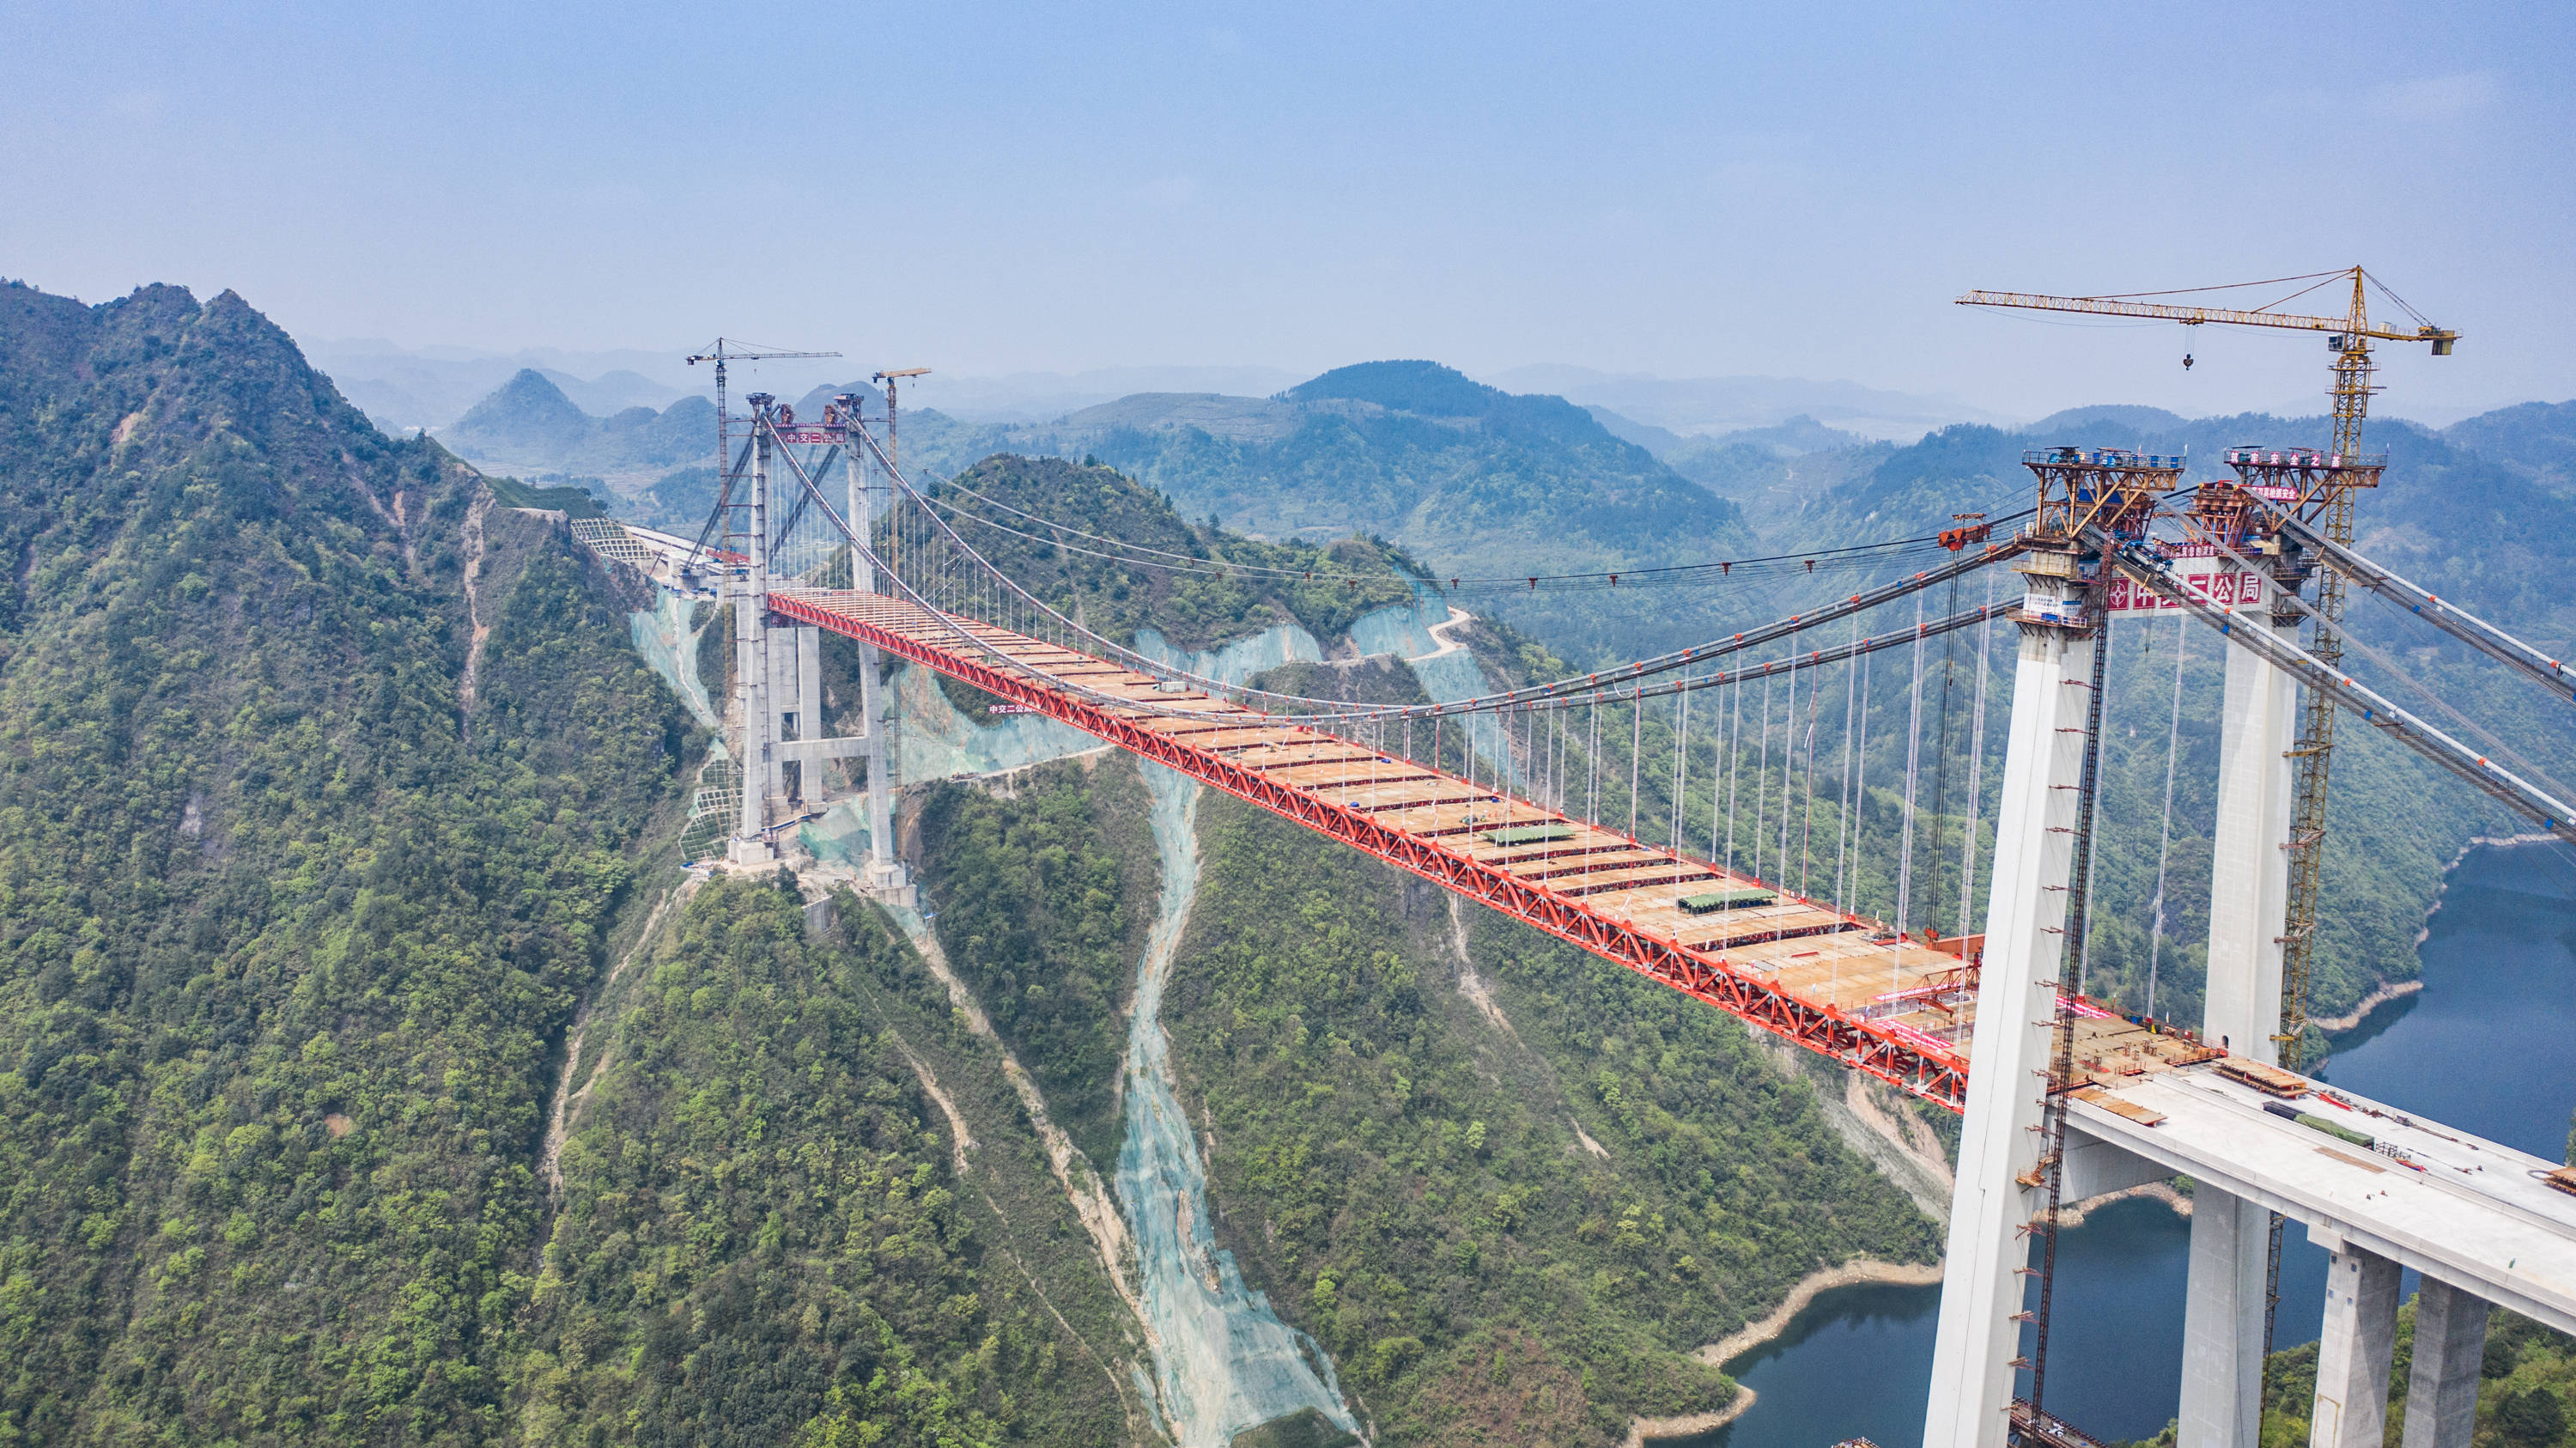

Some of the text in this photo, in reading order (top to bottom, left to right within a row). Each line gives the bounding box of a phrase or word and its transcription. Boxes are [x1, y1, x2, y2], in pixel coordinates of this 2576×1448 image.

[787, 433, 845, 442] 中交二公局
[2136, 575, 2259, 606] 中二公局
